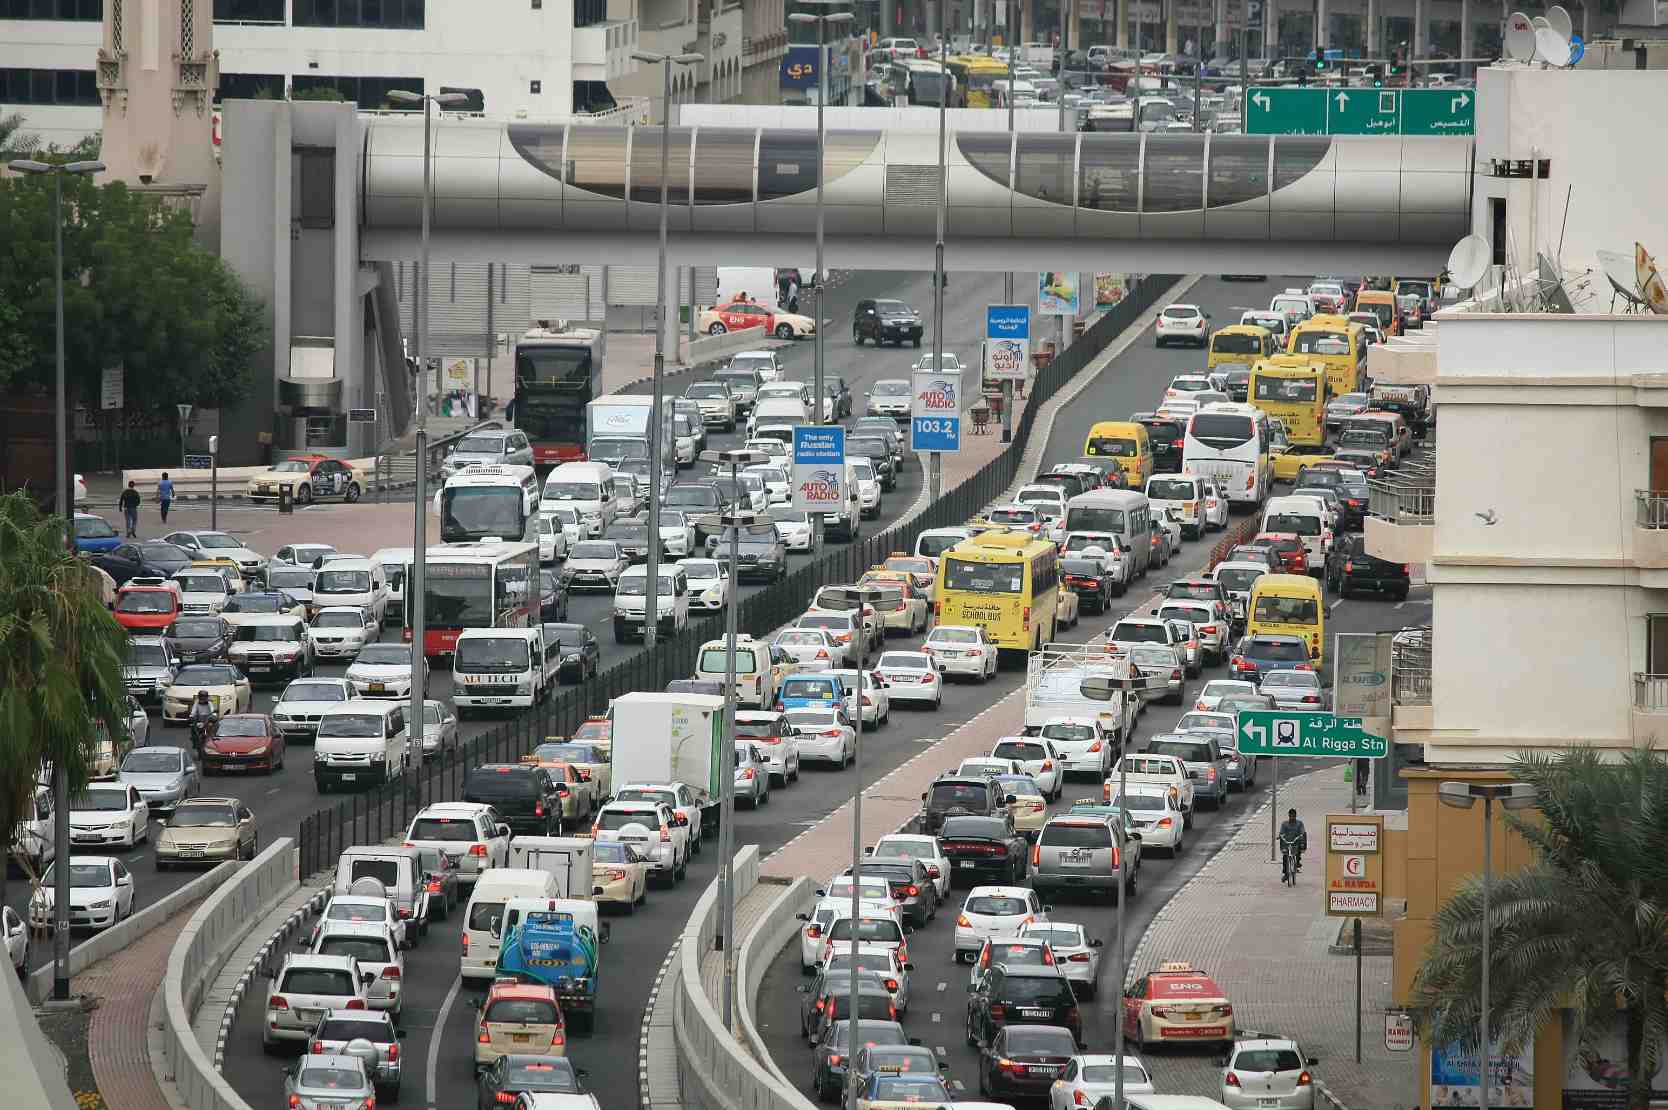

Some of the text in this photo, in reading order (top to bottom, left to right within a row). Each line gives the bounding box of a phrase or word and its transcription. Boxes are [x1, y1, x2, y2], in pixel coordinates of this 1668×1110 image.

[918, 391, 945, 400] AUTO
[926, 400, 956, 408] RADIO
[915, 420, 953, 433] 103.2
[800, 441, 836, 449] Russian
[800, 482, 828, 491] AUTO
[806, 491, 840, 500] RADIO
[1309, 717, 1337, 732] الرقة
[1303, 737, 1384, 752] Al Rigga Stn
[1331, 880, 1343, 889] AL
[1331, 896, 1376, 907] PHARMACY
